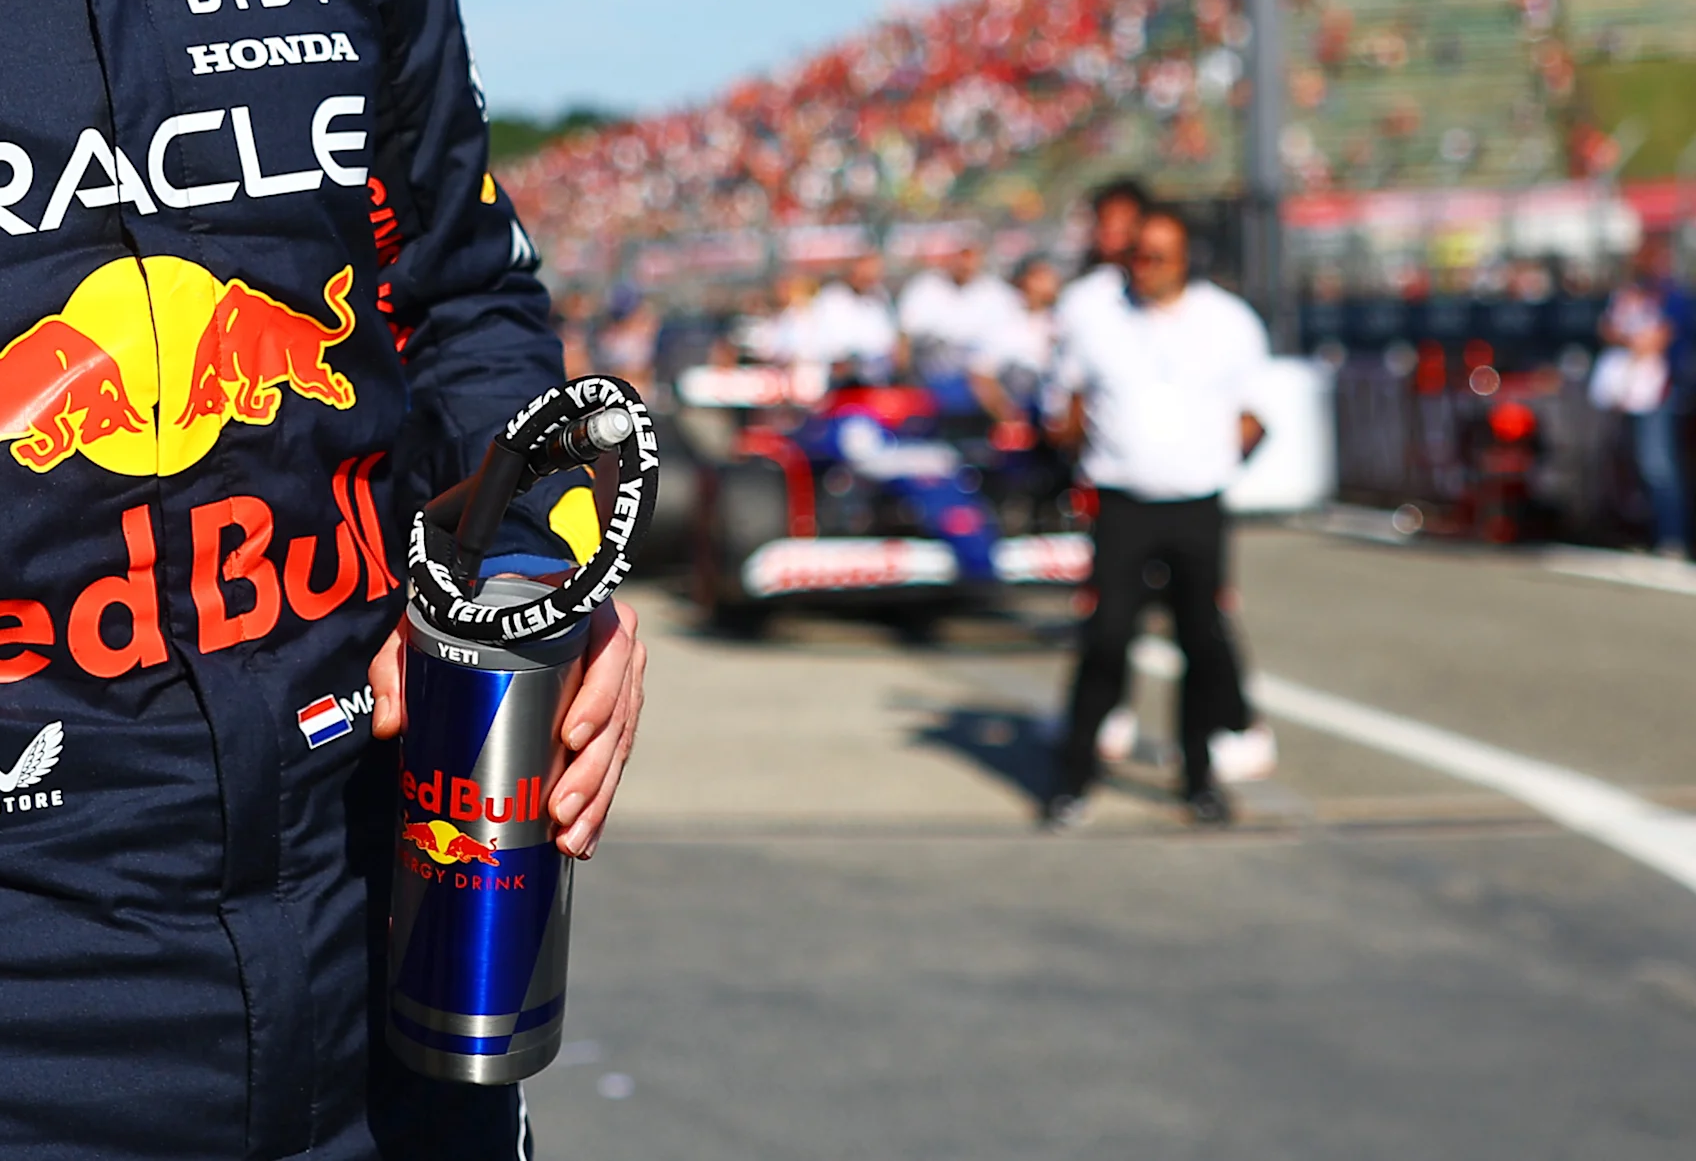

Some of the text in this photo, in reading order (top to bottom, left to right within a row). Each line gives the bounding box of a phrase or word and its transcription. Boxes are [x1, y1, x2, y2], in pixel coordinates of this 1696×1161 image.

[187, 33, 359, 75] HONDA
[565, 378, 623, 409] YETI
[630, 401, 660, 472] YETI
[605, 477, 643, 548] YETI
[190, 450, 399, 655] Bull
[572, 556, 632, 613] YETI
[501, 598, 566, 640] YETI
[437, 642, 479, 665] YETI
[401, 769, 541, 823] ed Bull
[455, 873, 526, 891] DRINK
